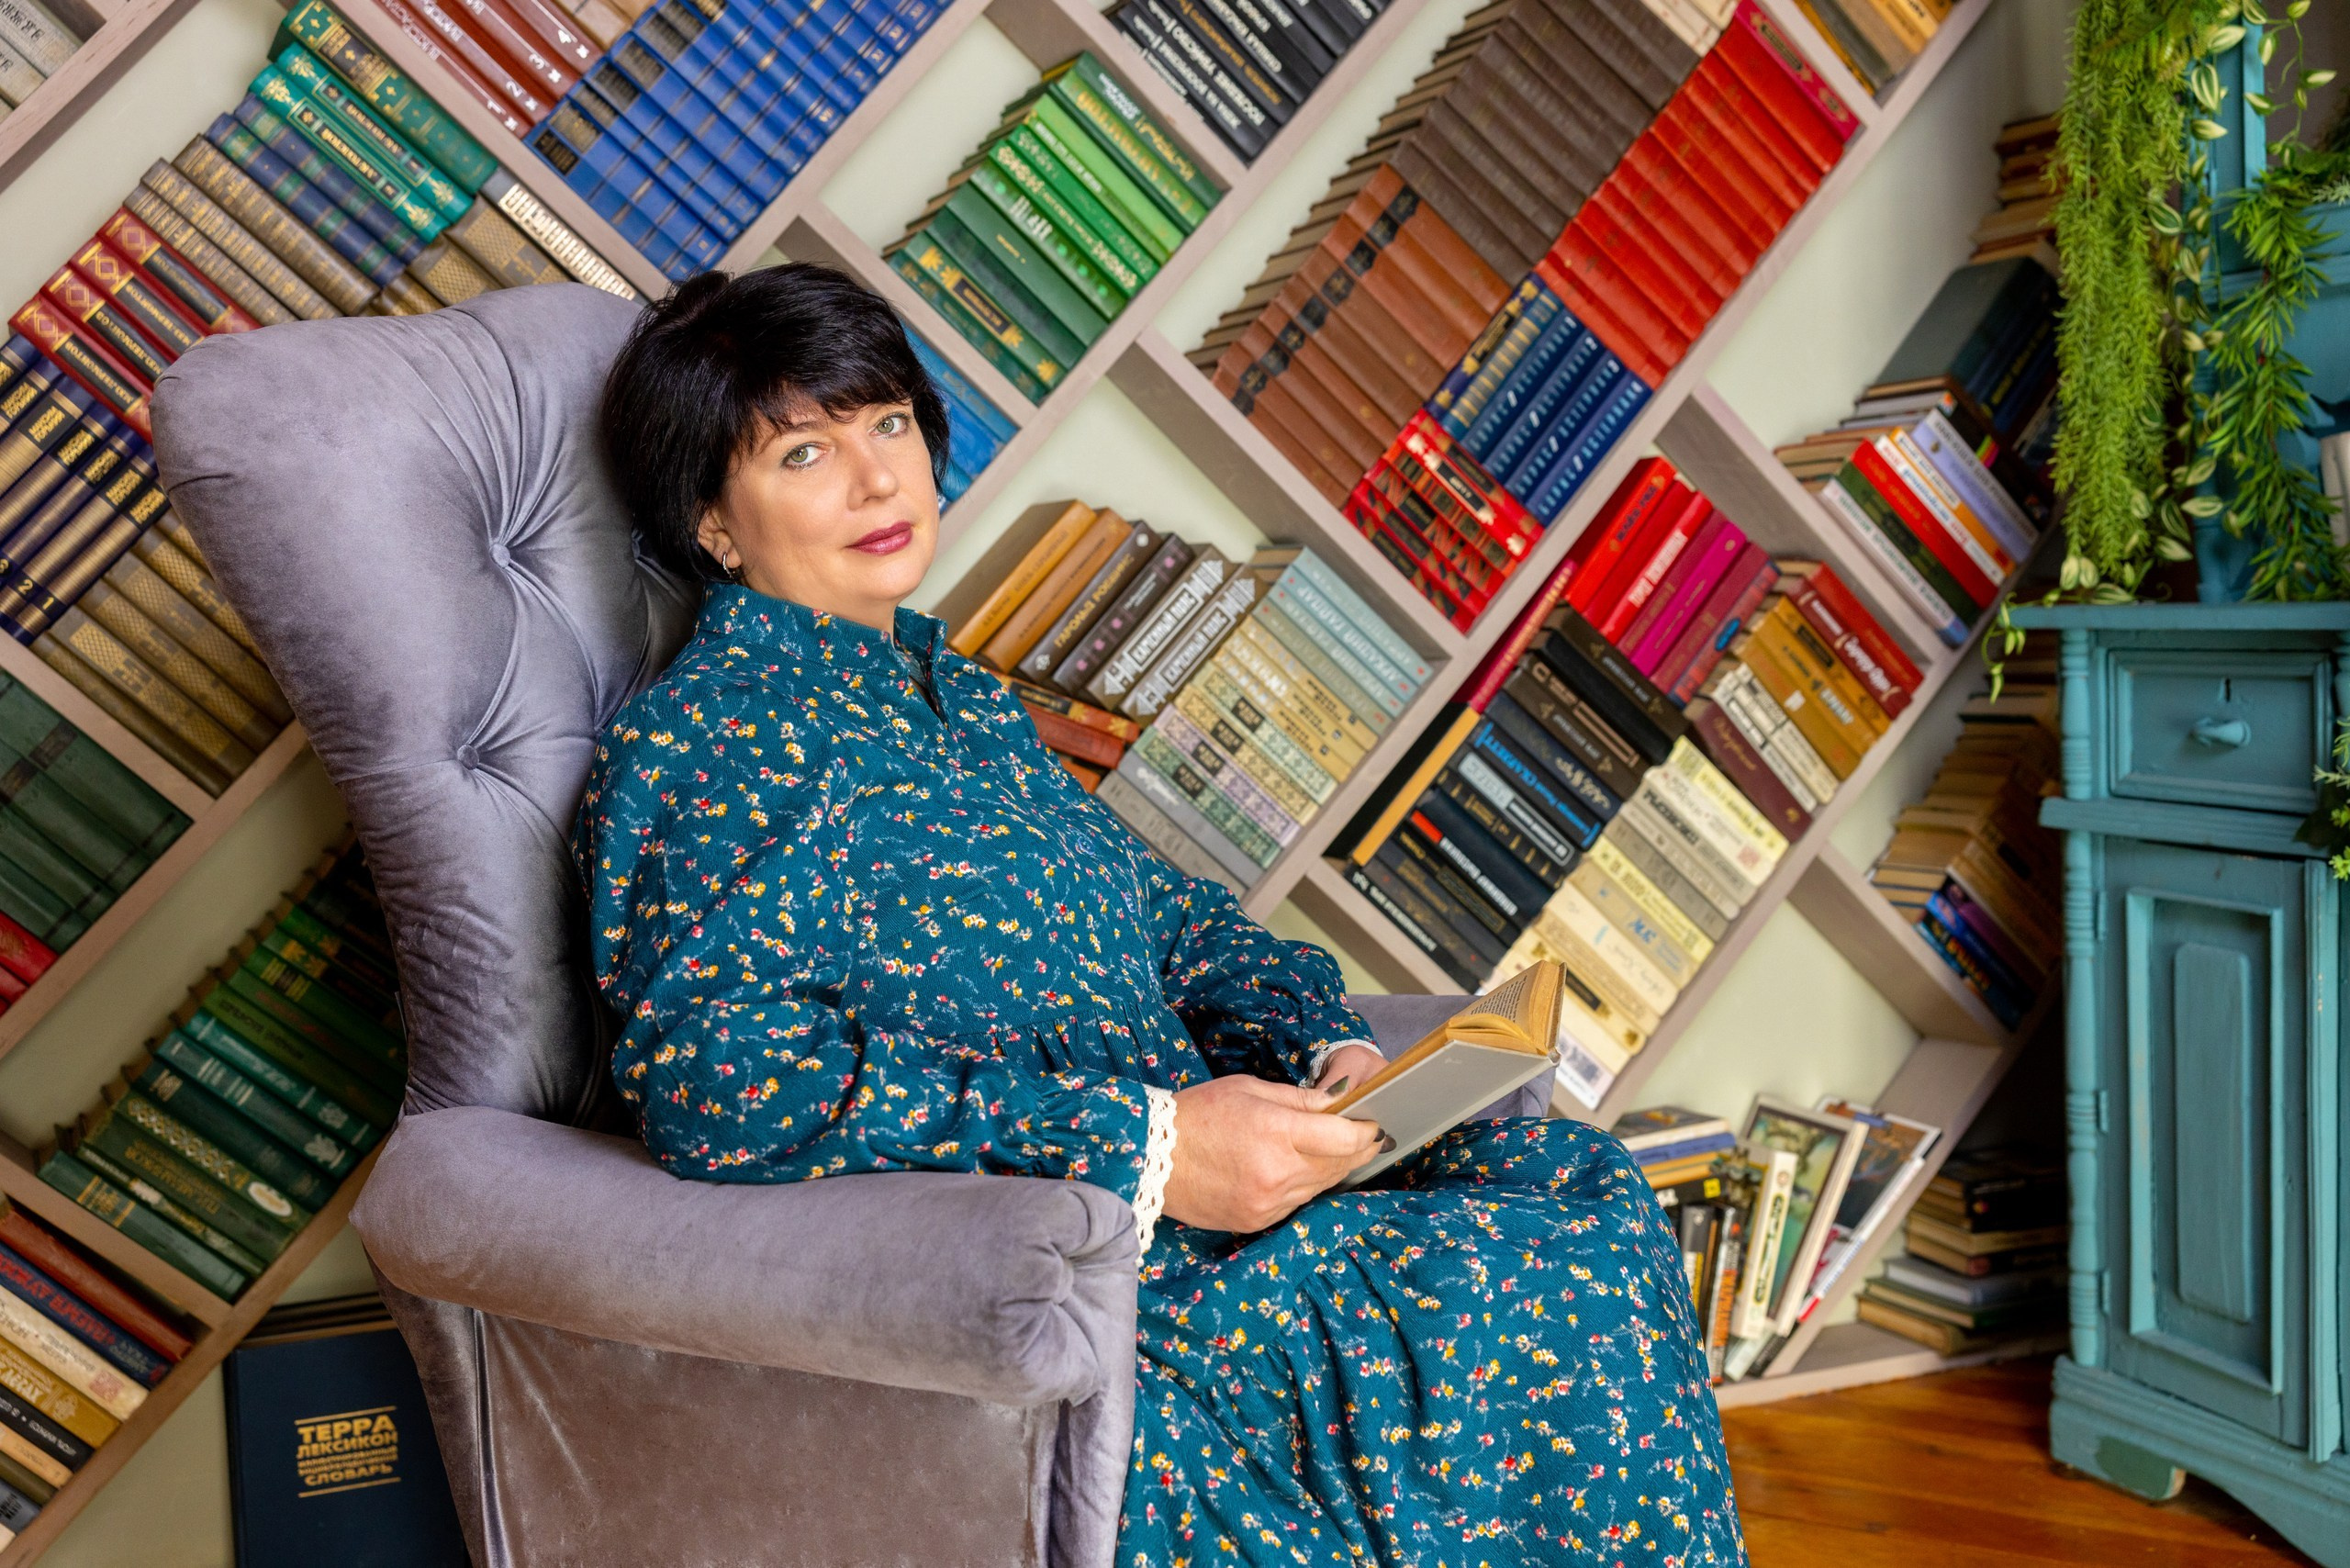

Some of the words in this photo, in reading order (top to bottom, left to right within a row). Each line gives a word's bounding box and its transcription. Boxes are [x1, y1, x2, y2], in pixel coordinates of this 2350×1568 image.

[16, 576, 36, 597] 2
[39, 593, 57, 612] 1
[1053, 599, 1096, 648] ГАРОЛЬД
[1091, 553, 1136, 602] РОББИНС
[1130, 612, 1179, 662] КАМЕННЫЙ
[1169, 591, 1197, 620] ПОЯС
[1295, 582, 1346, 633] ГАЙДАР
[1163, 633, 1210, 681] КАМЕННЫЙ
[1203, 611, 1229, 638] ПОЯС
[1340, 628, 1402, 683] АРКАДИЙ
[297, 1415, 397, 1444] ТЕРРА
[297, 1431, 399, 1459] ЛЕКСИКОН
[304, 1464, 395, 1487] СЛОВАРЬ
